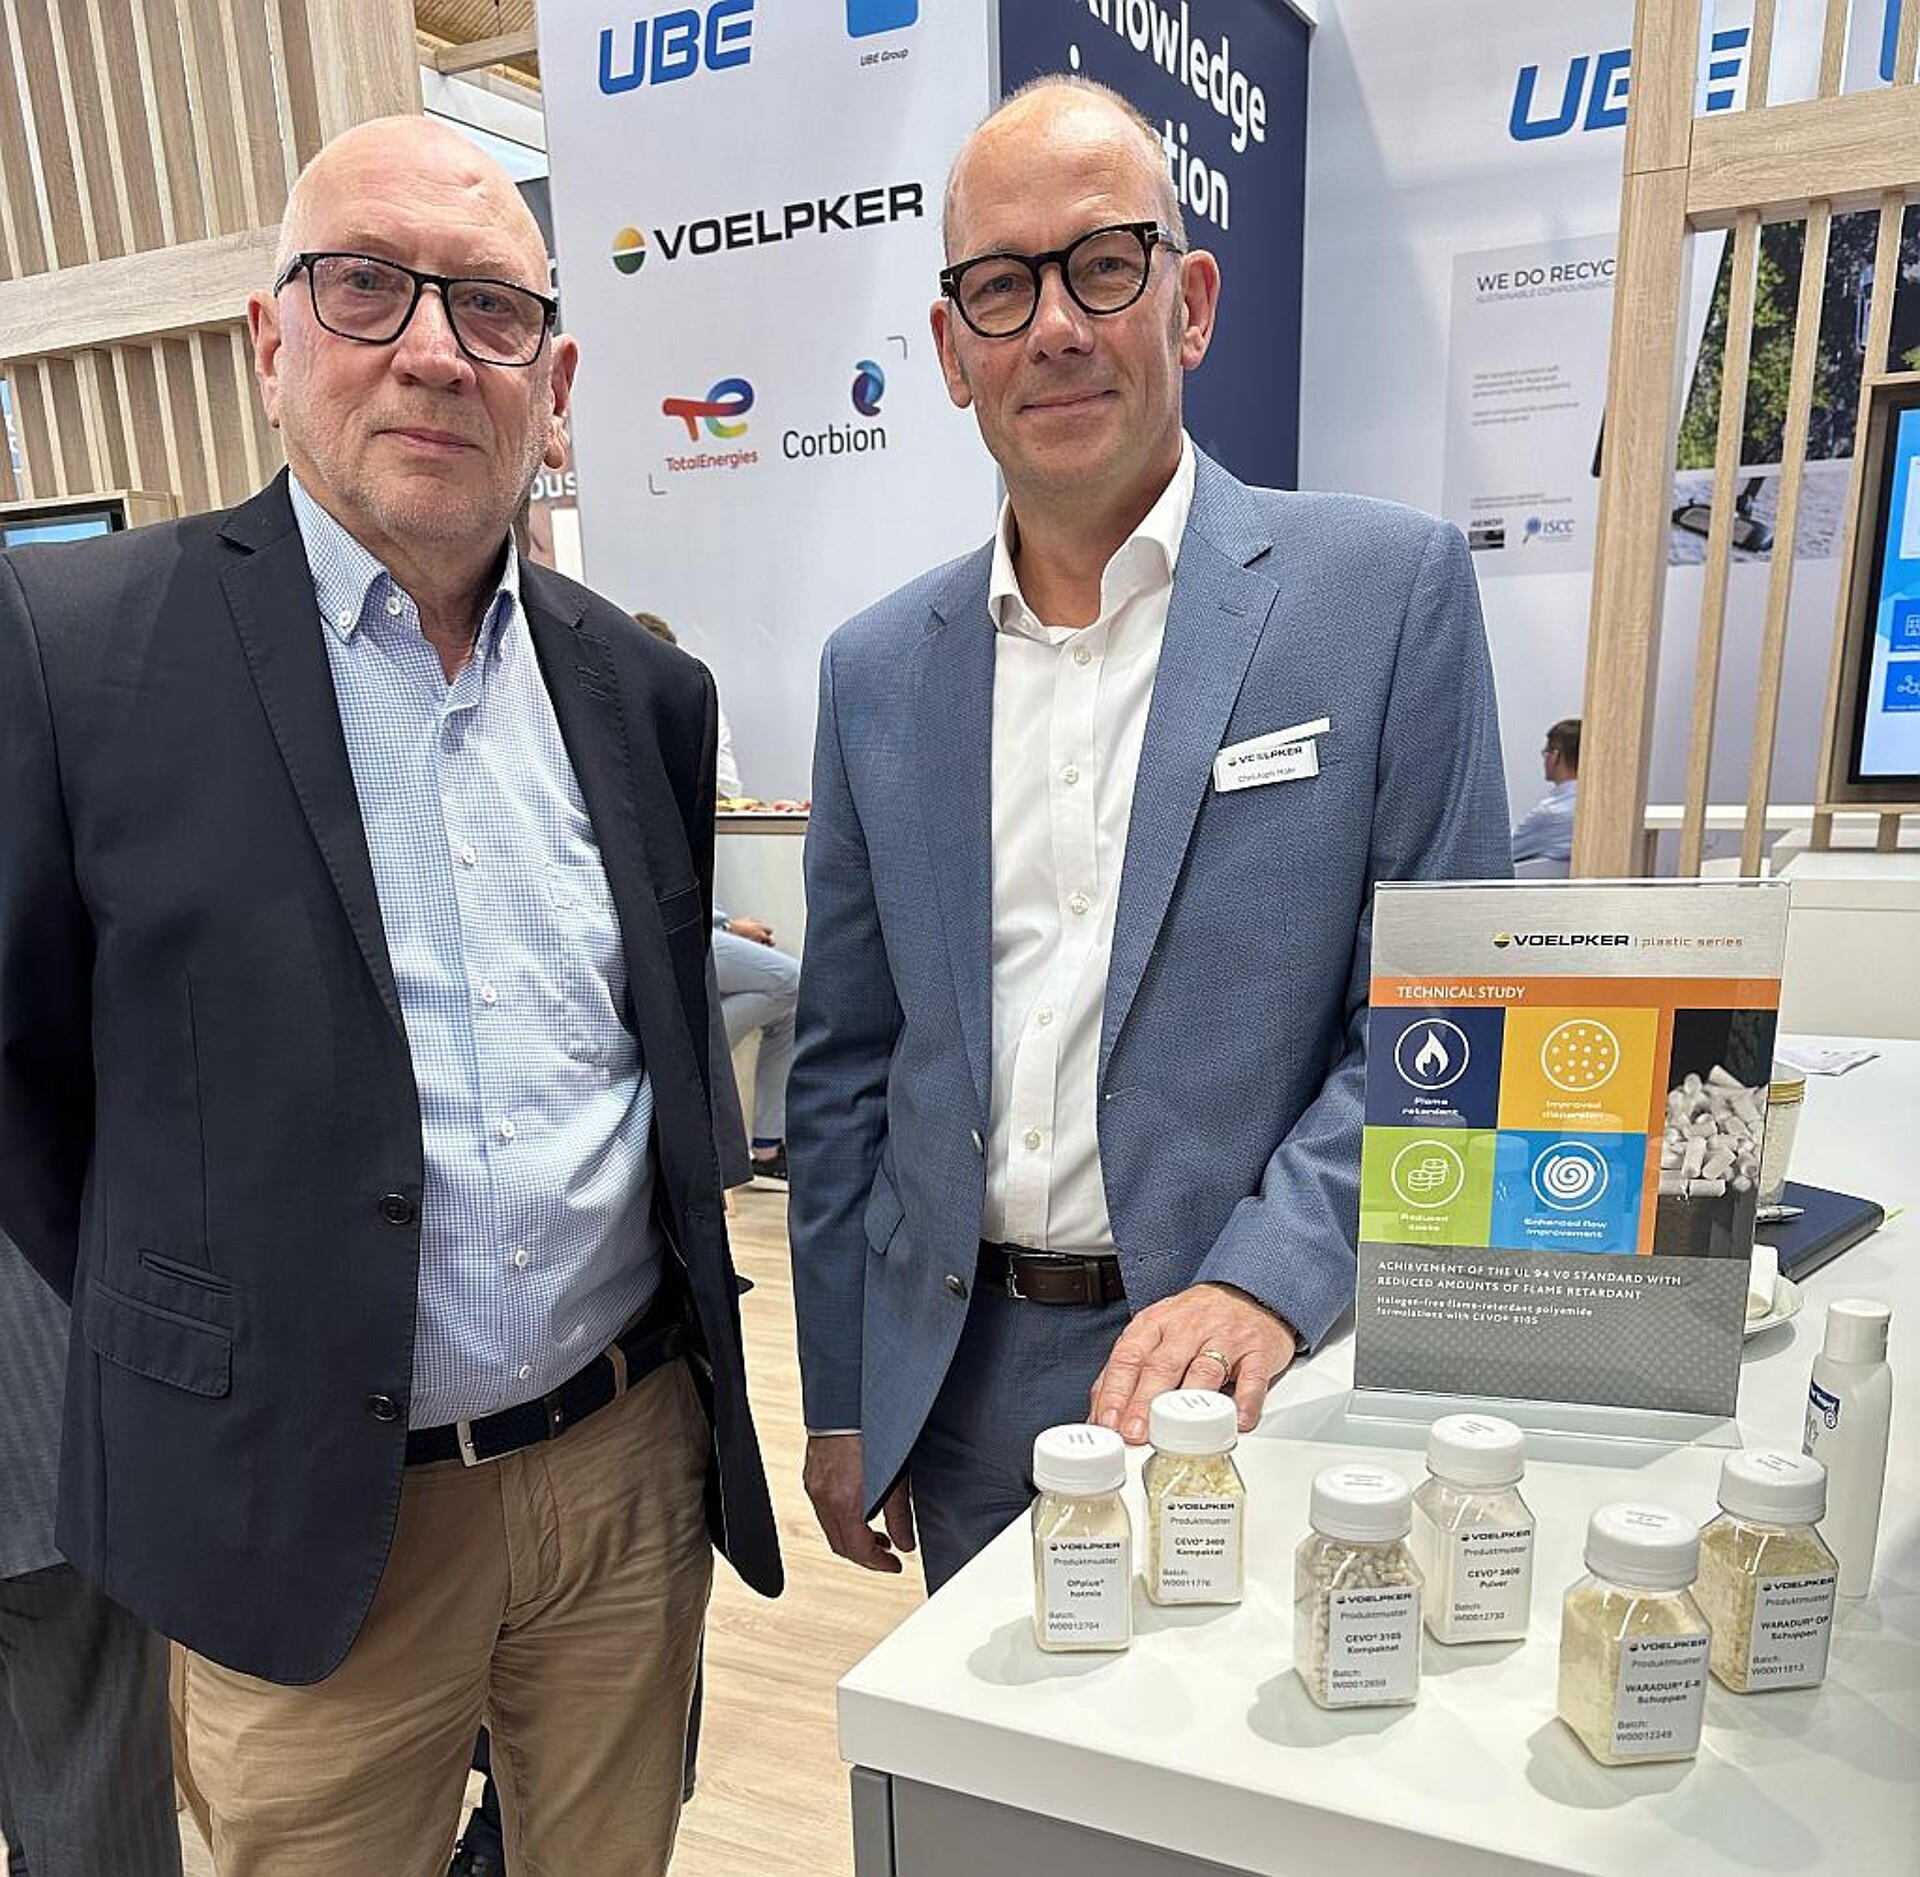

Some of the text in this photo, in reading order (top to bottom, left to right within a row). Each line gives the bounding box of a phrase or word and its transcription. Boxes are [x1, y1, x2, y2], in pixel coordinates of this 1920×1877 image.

[600, 0, 755, 95] UBE
[860, 48, 909, 66] UBE Group
[1080, 0, 1267, 153] nowledge
[1162, 119, 1229, 231] tion
[653, 182, 924, 260] VOELPKER
[1477, 259, 1615, 291] WE DO RECYC
[782, 424, 887, 459] Corbion
[665, 449, 759, 474] TotalEnergies
[530, 471, 577, 500] ous
[1542, 519, 1575, 534] ISCC
[1513, 934, 1743, 948] VOELPKER plastic series
[1397, 985, 1526, 1000] TECHNICAL STUDY
[1414, 1097, 1449, 1106] Flame
[1400, 1213, 1449, 1223] Reduced
[1524, 1217, 1608, 1229] Enhanced flow
[1526, 1228, 1604, 1239] improvement
[1378, 1261, 1463, 1274] ACHIEVEMENT
[1467, 1265, 1484, 1275] OF
[1488, 1266, 1511, 1276] THE
[1514, 1267, 1531, 1278] UL
[1574, 1270, 1643, 1284] STANDARD
[1647, 1274, 1681, 1286] WITH
[1377, 1276, 1642, 1300] REDUCED AMOUNTS OF FLAME RETARDANT
[1471, 1529, 1531, 1540] VOELPKER
[1060, 1542, 1120, 1550] VOELPKER
[1773, 1577, 1834, 1589] VOELPKER
[1348, 1592, 1412, 1603] VOELPKER
[1641, 1639, 1707, 1650] VOELPKER
